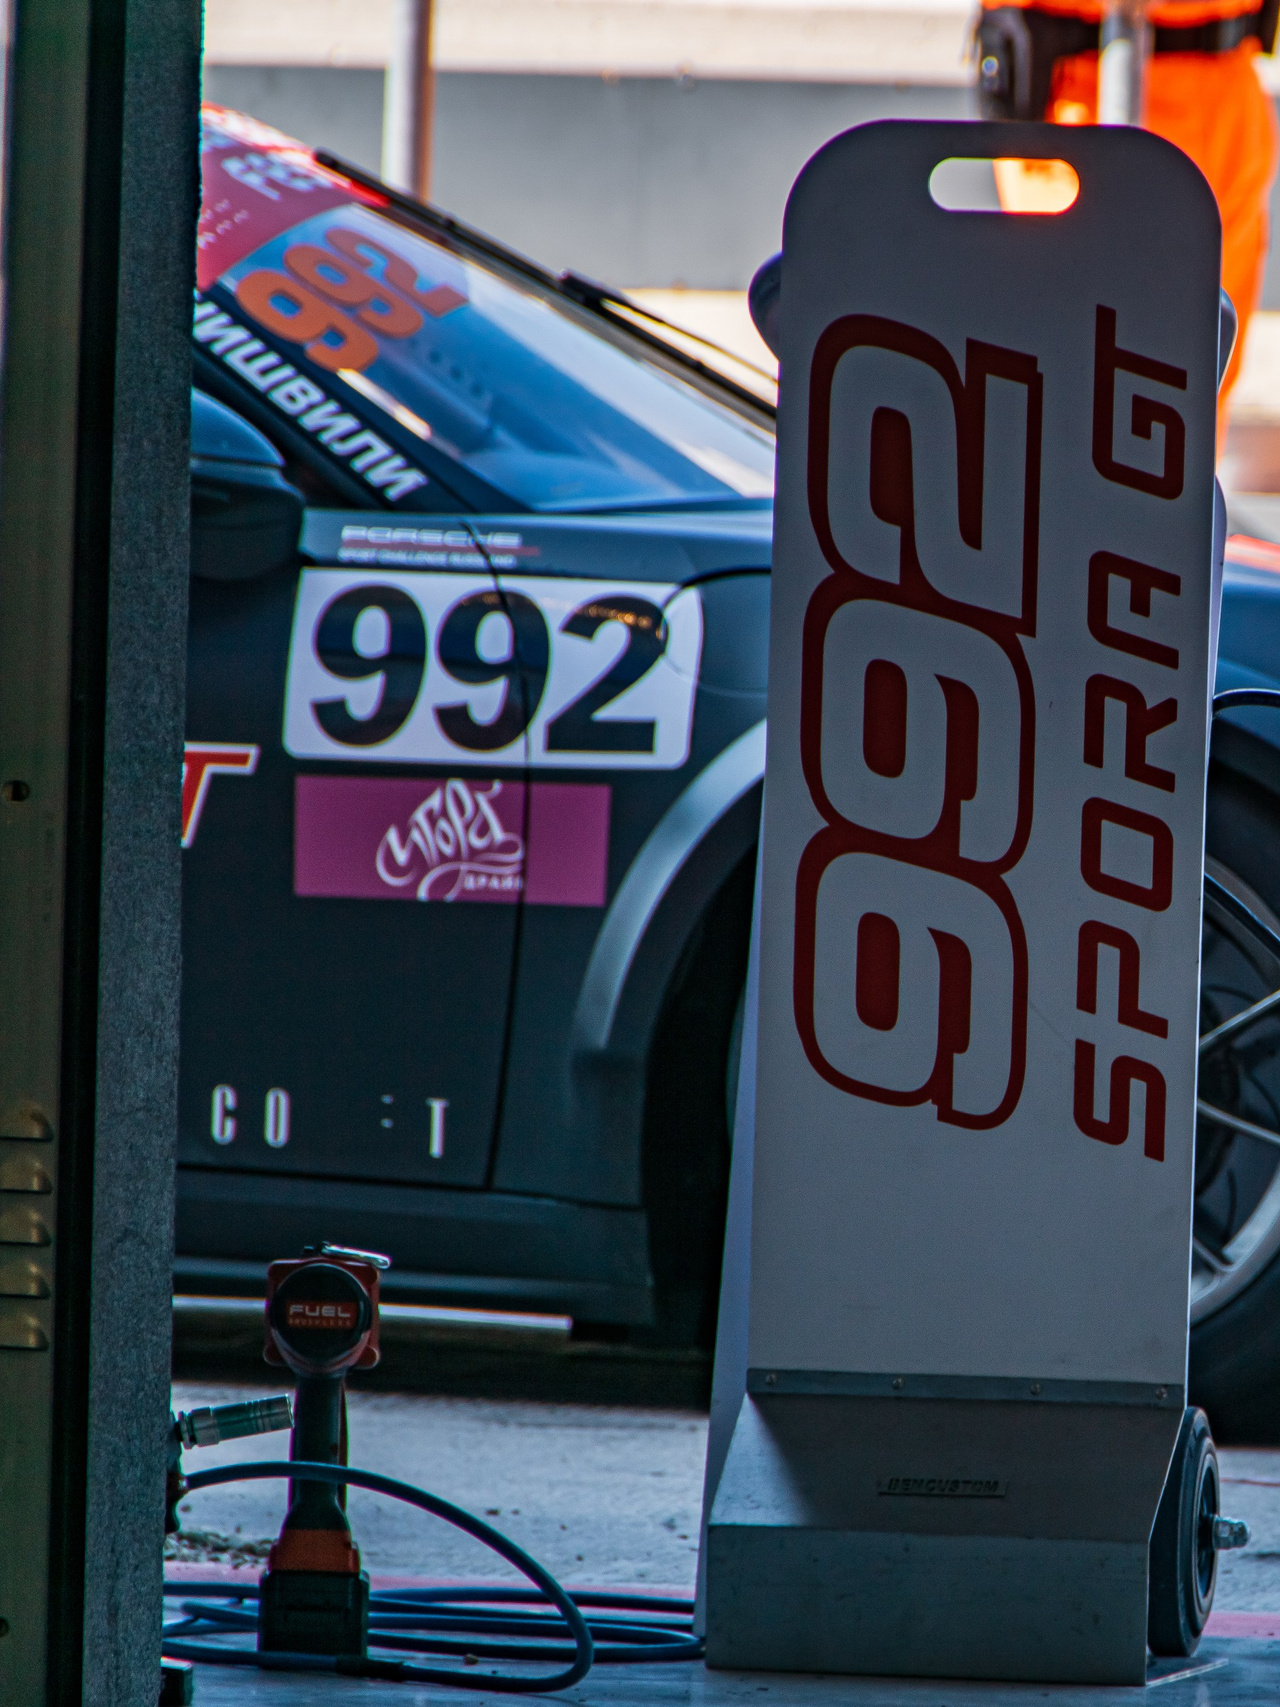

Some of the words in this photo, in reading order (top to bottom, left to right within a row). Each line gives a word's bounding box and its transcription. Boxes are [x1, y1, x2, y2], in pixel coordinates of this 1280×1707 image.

[234, 227, 469, 374] 992
[1092, 304, 1188, 500] GT
[310, 583, 667, 755] 992
[793, 313, 1043, 1131] 992
[1073, 550, 1182, 1163] SPORA
[289, 1303, 351, 1318] FUEL
